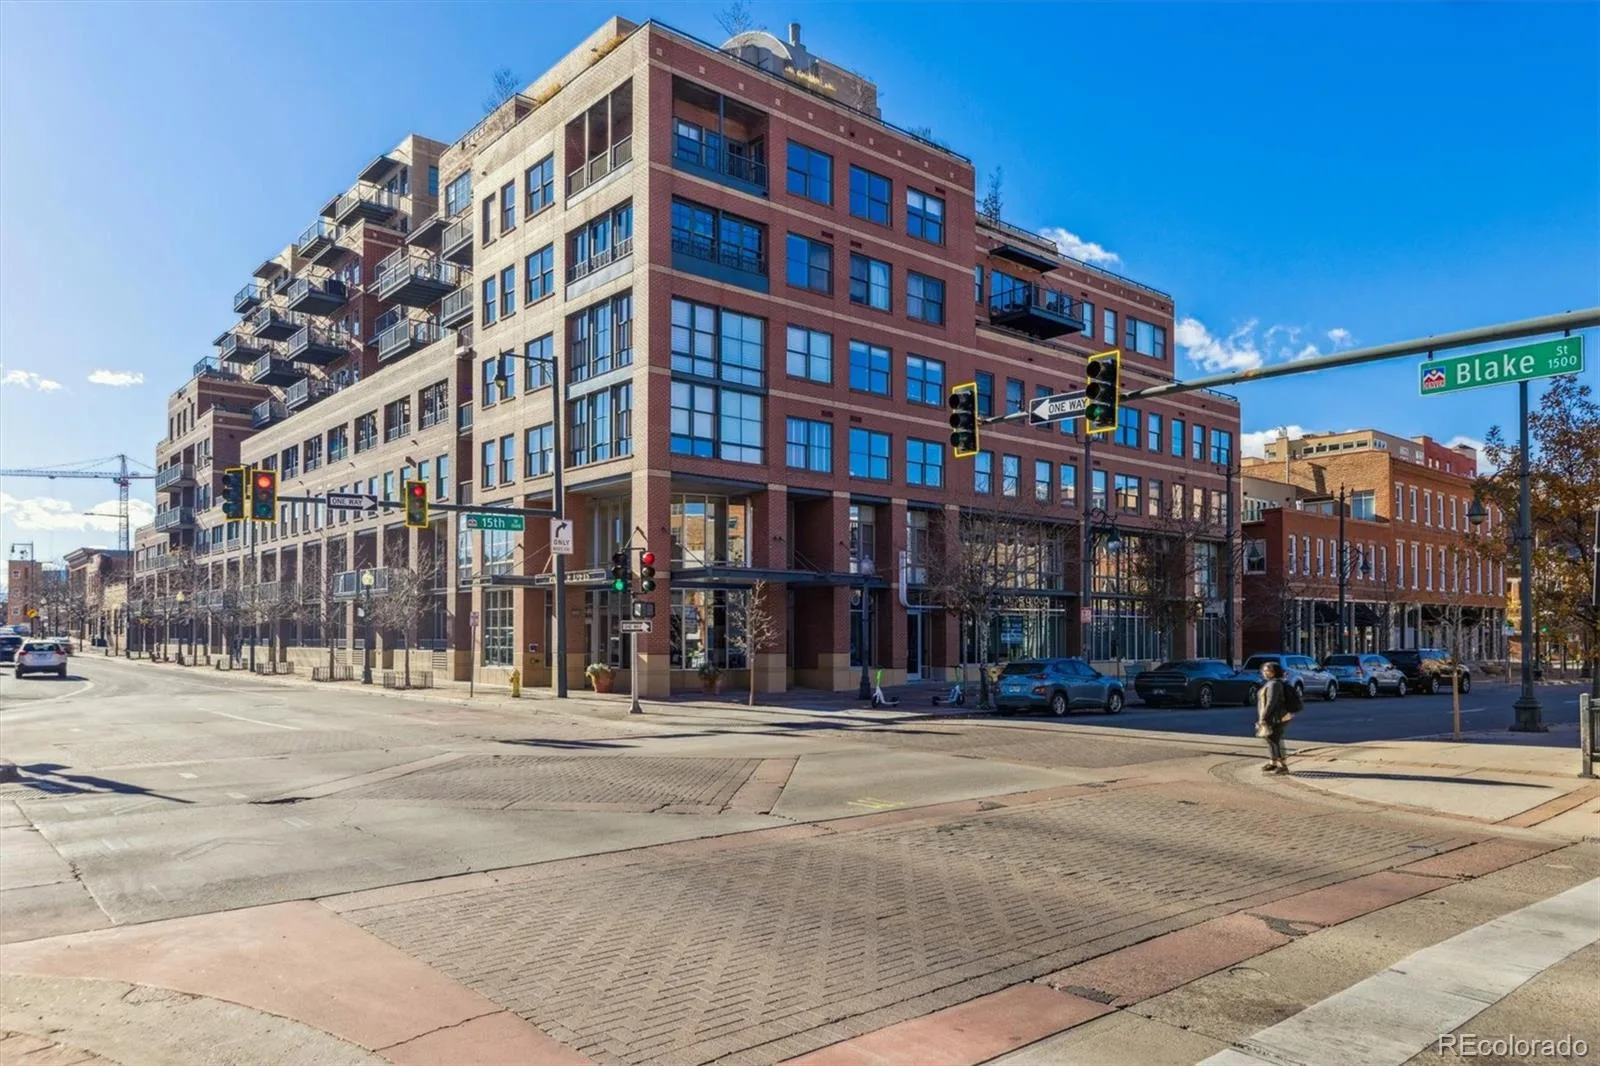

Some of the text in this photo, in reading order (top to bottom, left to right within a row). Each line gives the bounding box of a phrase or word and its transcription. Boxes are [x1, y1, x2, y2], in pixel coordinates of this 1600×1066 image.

[1556, 345, 1568, 356] St
[1548, 355, 1577, 369] 1500
[1456, 354, 1535, 385] Blake
[1049, 398, 1088, 413] ONE WAY
[331, 497, 345, 505] ONE
[481, 517, 506, 529] 15th
